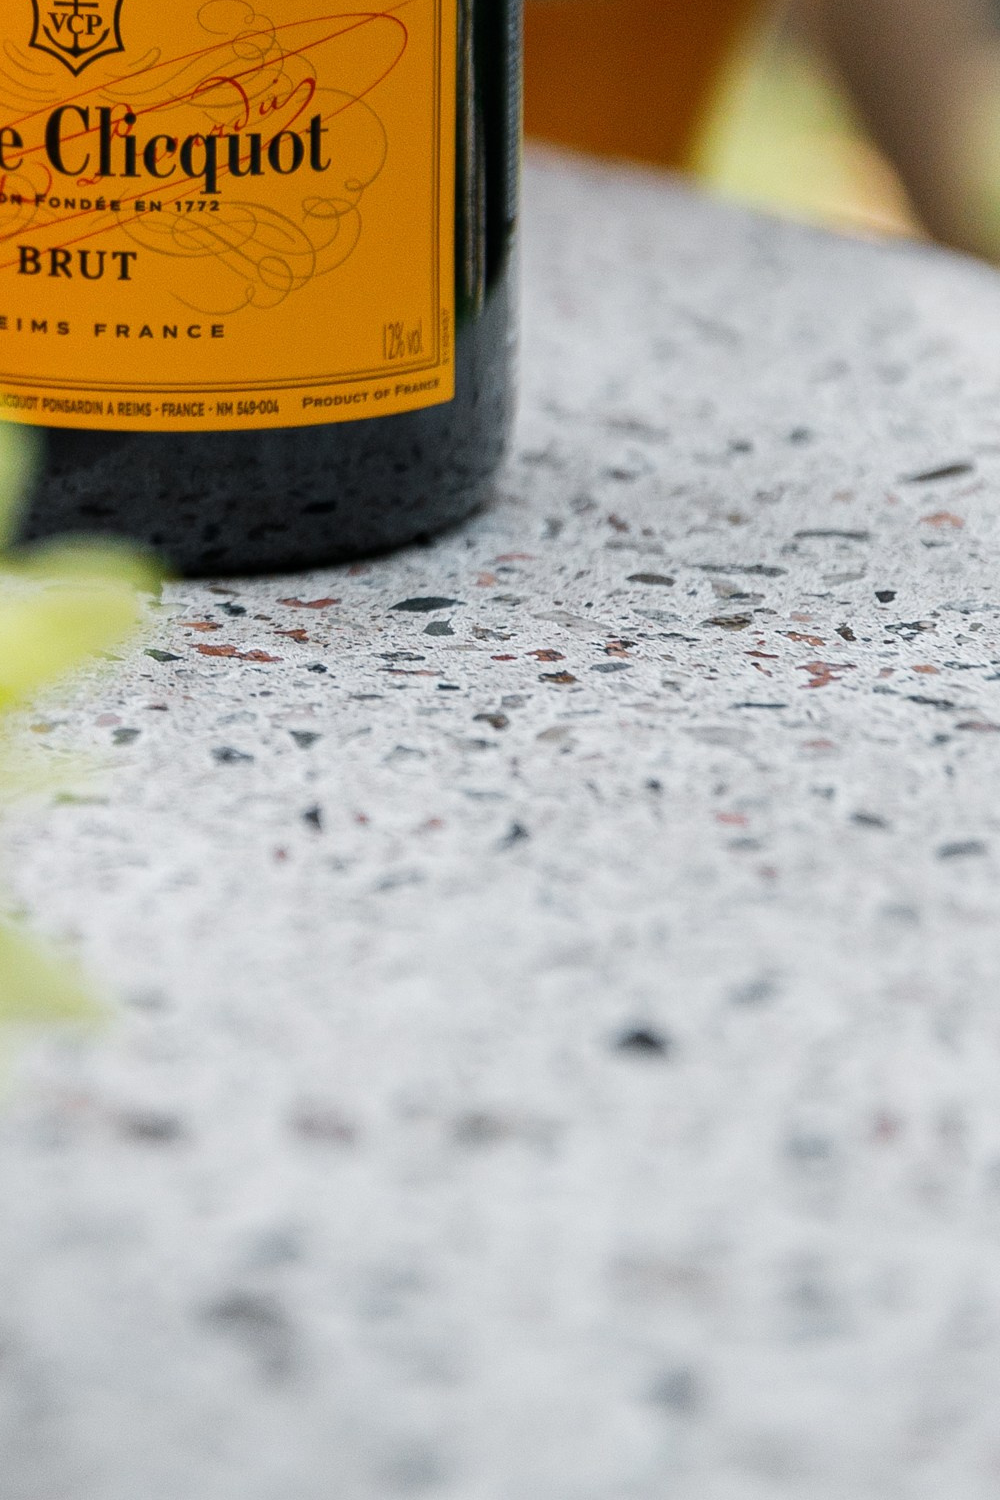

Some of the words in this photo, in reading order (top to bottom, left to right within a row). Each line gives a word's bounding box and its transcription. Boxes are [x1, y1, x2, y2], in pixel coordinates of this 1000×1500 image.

[47, 11, 103, 36] VCP
[43, 105, 332, 194] Clicquot
[35, 193, 121, 212] FONDÉE
[134, 200, 162, 212] EN
[176, 200, 221, 212] 1772
[17, 245, 137, 282] BRUT
[93, 323, 226, 339] FRANCE
[382, 321, 404, 361] 12%
[42, 398, 103, 416] PONSARDIN
[117, 401, 152, 417] REIMS
[161, 402, 205, 417] FRANCE
[216, 401, 234, 416] NM
[236, 399, 280, 416] 549-004
[302, 391, 369, 409] PRODUCT
[373, 387, 392, 400] OF
[394, 378, 440, 397] FRANCE
